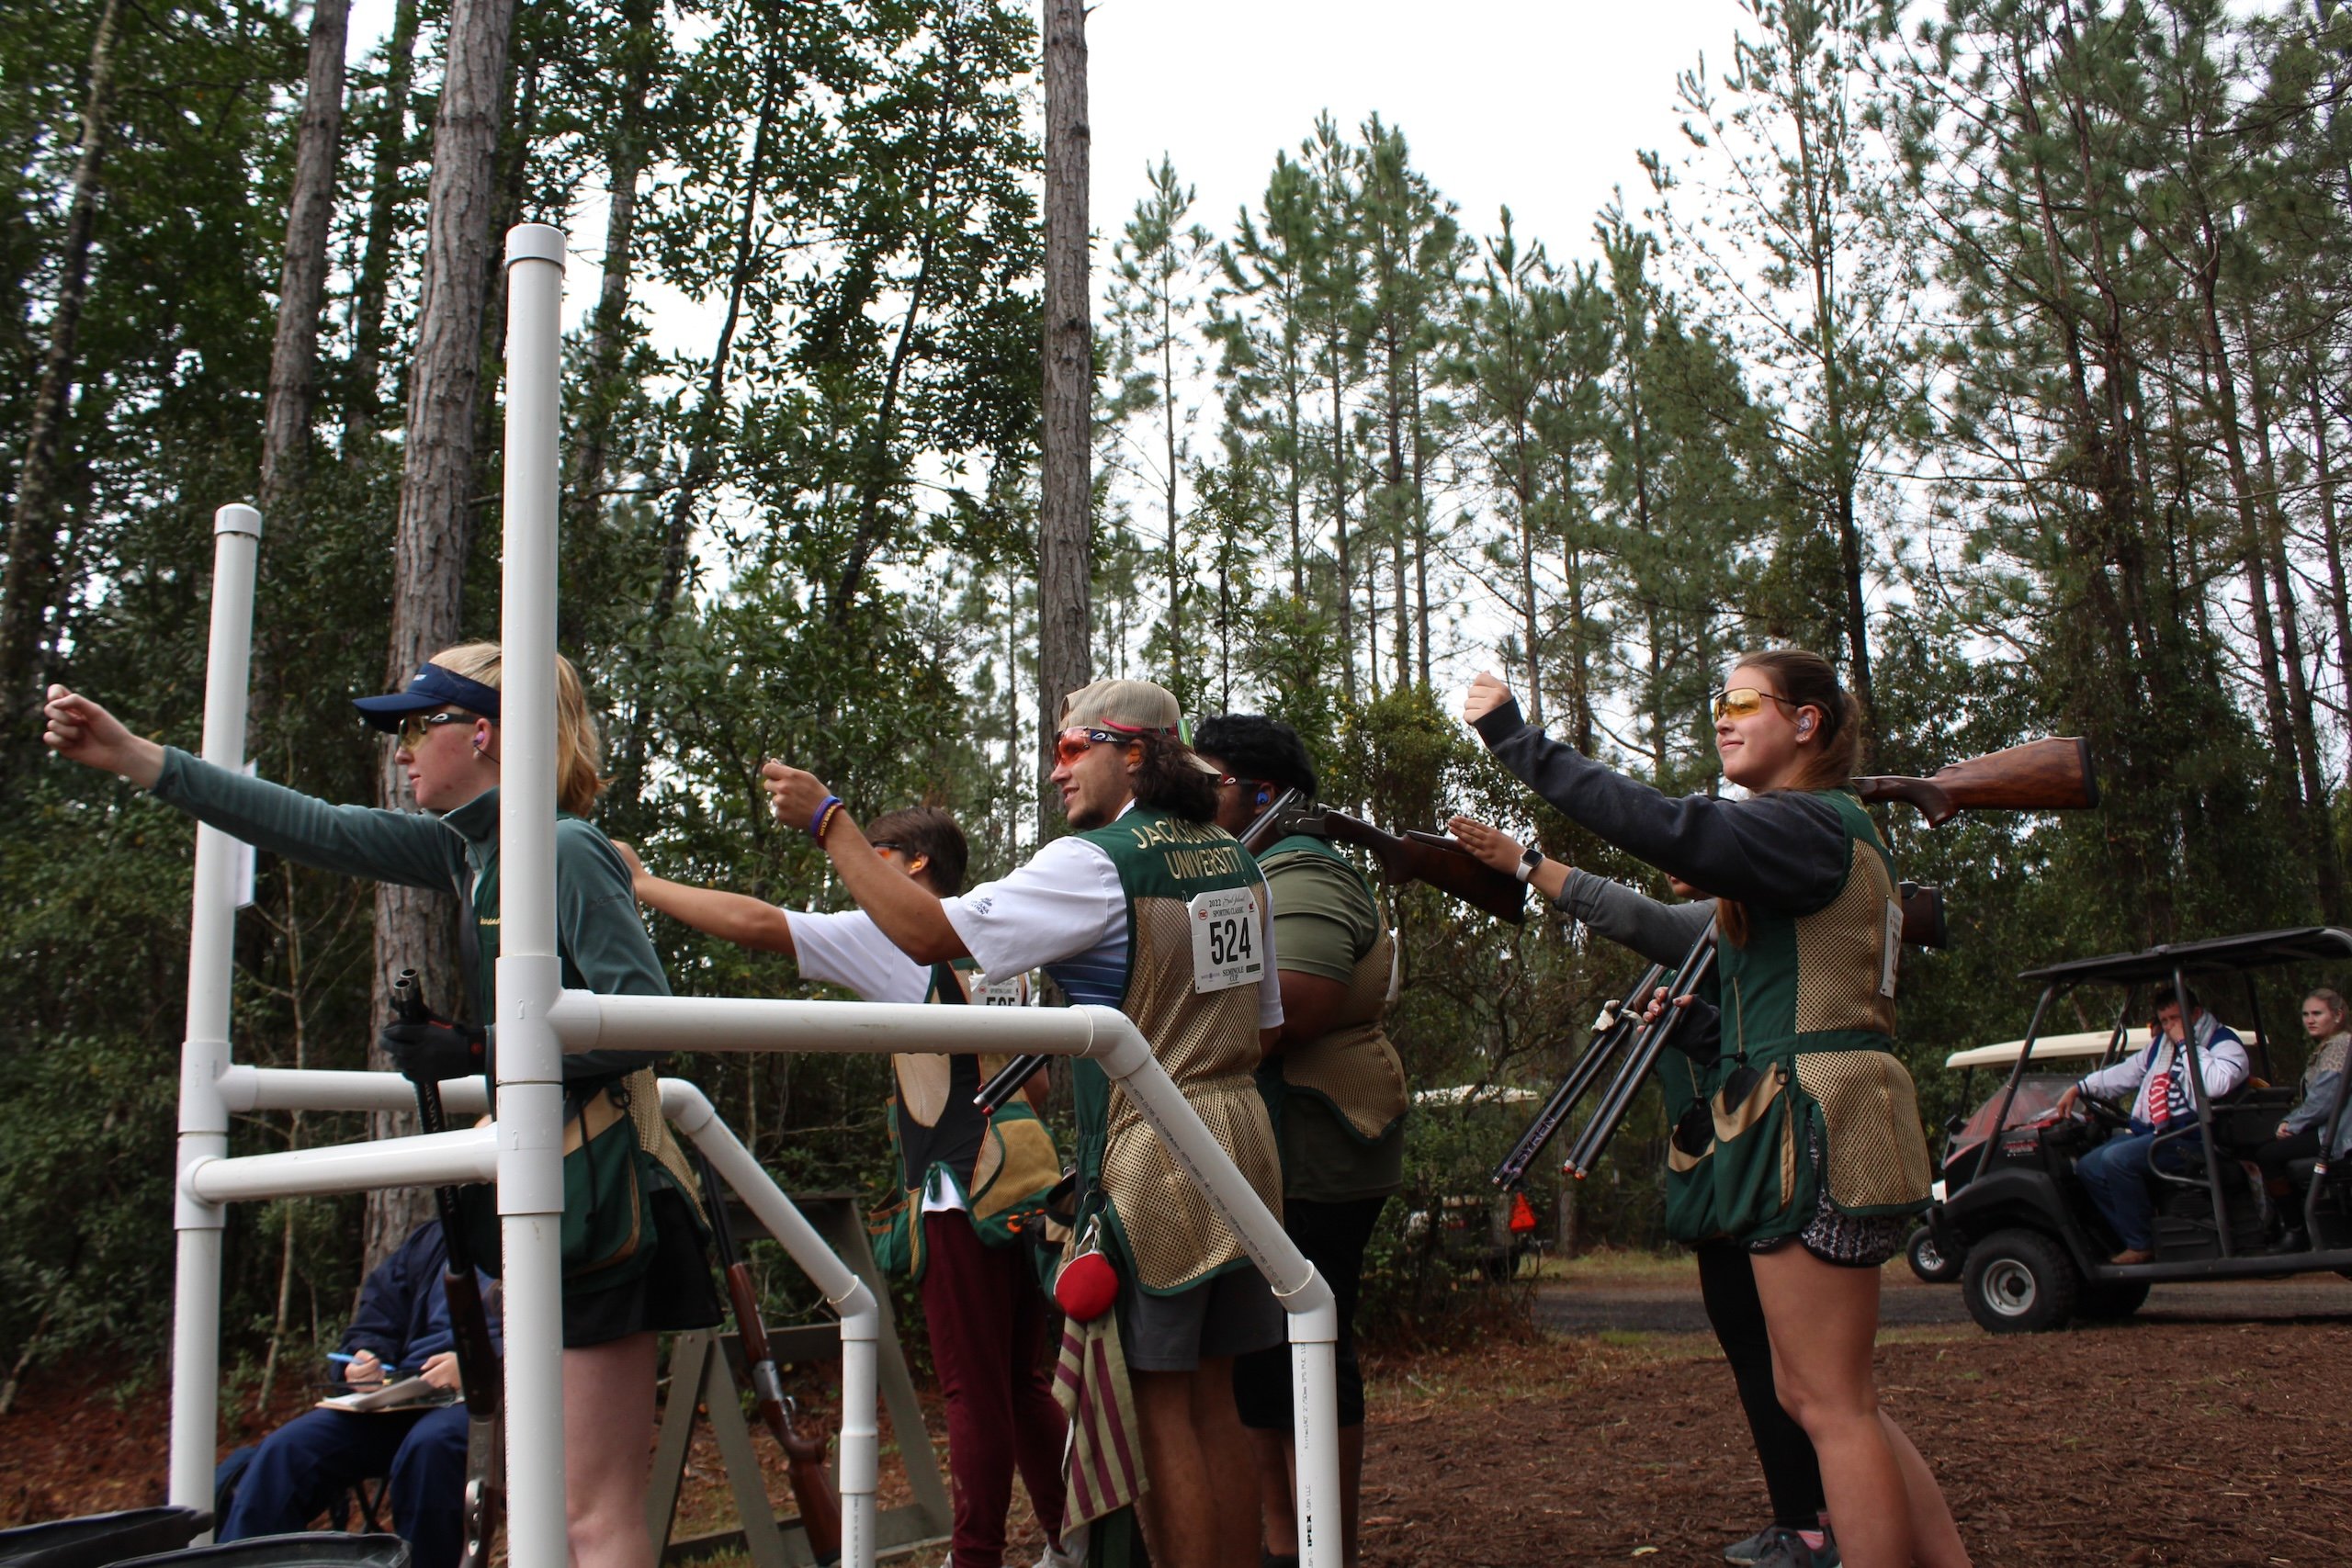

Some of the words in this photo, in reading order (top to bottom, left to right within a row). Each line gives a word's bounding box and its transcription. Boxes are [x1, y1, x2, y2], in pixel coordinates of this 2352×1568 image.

[1164, 845, 1244, 879] UNIVERSITY
[1209, 898, 1221, 908] 2022
[1213, 908, 1230, 917] SPORTING
[1230, 906, 1244, 914] CLASSIC
[1210, 917, 1251, 964] 524
[1223, 966, 1244, 976] SEMINOLE
[1229, 974, 1238, 982] CUP
[1518, 1115, 1555, 1162] SYREN
